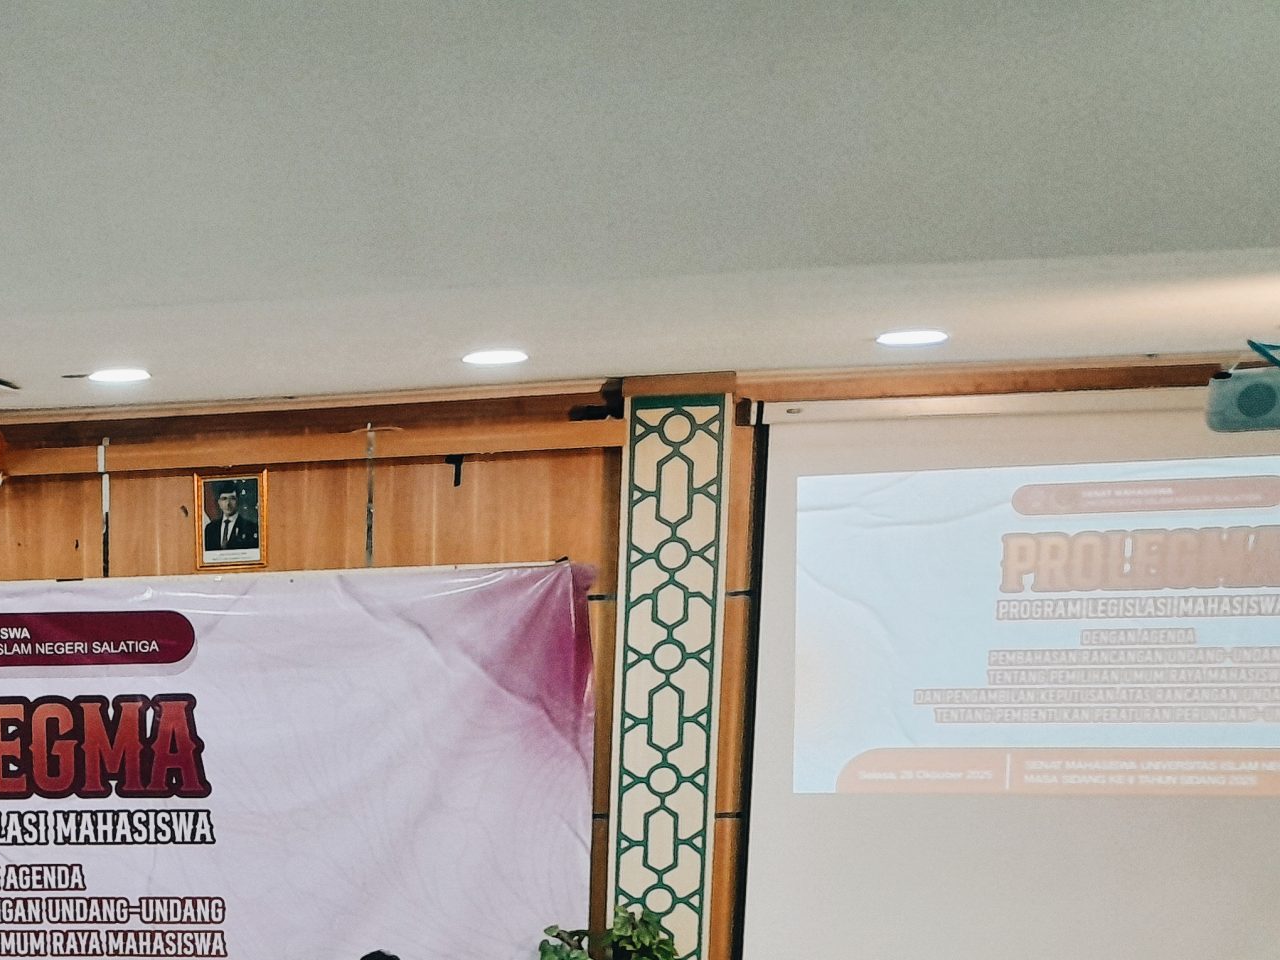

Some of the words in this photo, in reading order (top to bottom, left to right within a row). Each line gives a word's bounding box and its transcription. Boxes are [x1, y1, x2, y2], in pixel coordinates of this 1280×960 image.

[996, 598, 1084, 620] PROGRAM
[1086, 596, 1173, 619] LEGISLASI
[36, 642, 89, 655] NEGERI
[92, 640, 159, 654] SALATIGA
[53, 809, 216, 845] MAHASISWA
[3, 864, 86, 891] AGENDA
[45, 896, 226, 924] UNDANG-UNDANG
[49, 930, 105, 956] RAYA
[106, 930, 228, 957] MAHASISWA
